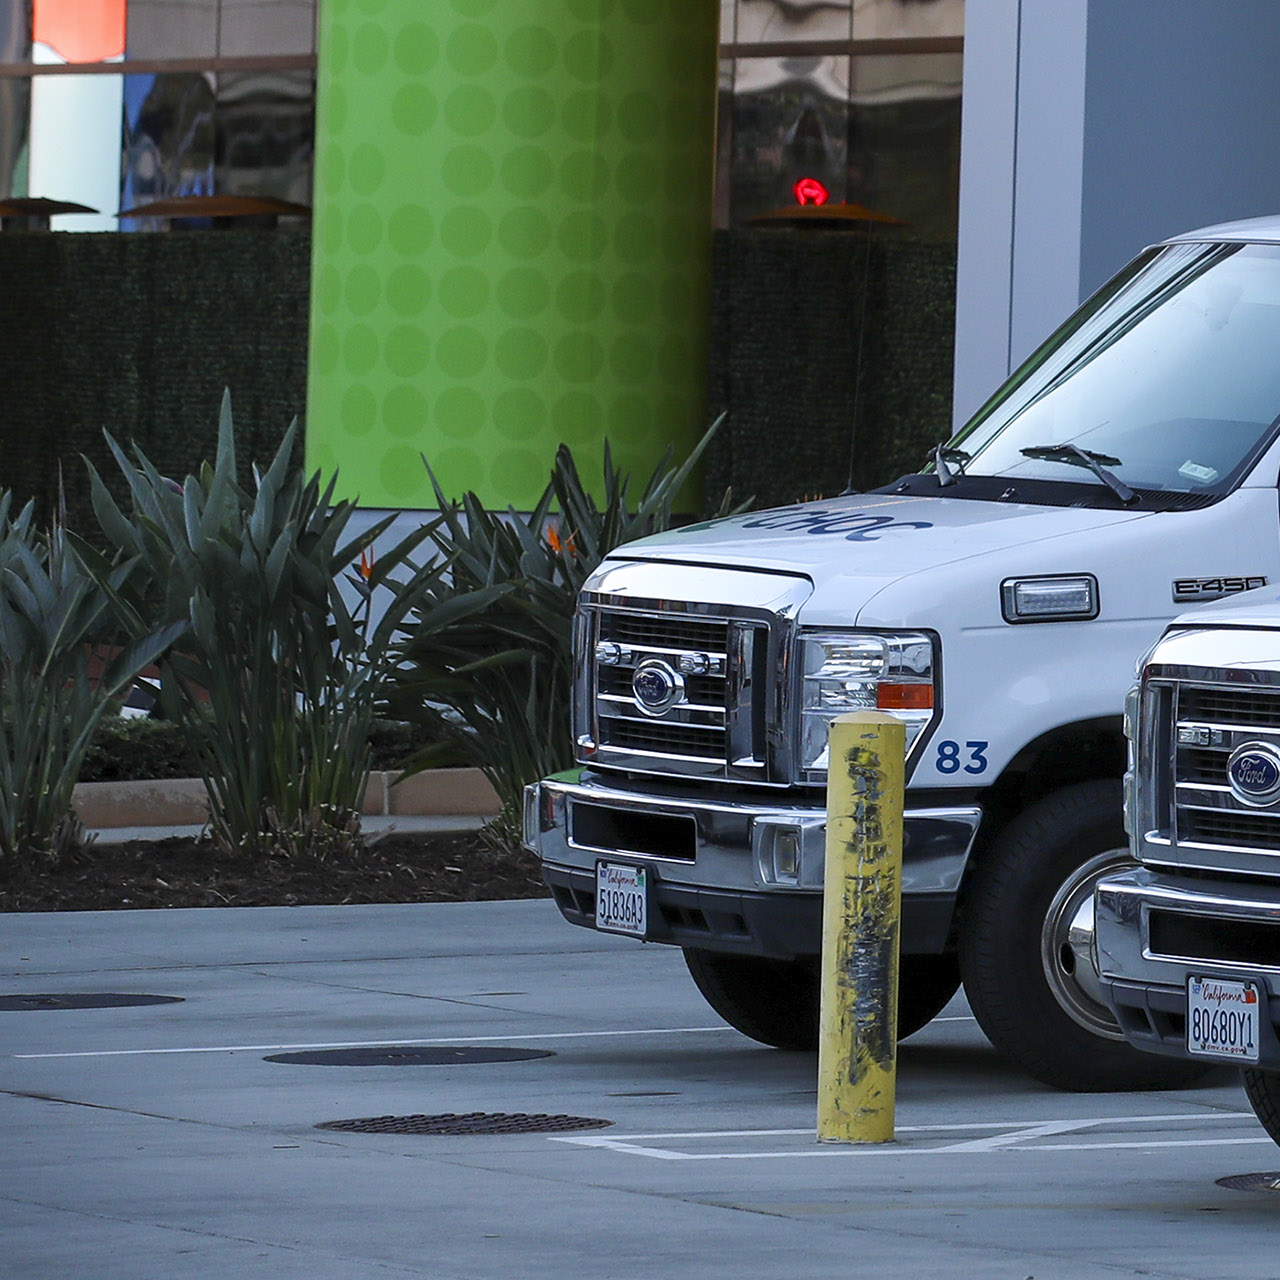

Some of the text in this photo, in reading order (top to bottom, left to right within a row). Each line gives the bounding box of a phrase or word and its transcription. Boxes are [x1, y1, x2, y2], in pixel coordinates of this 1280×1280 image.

[936, 740, 988, 774] 83
[1237, 757, 1267, 784] Ford
[599, 888, 644, 924] 51836A3
[1202, 983, 1246, 1007] California
[1192, 1007, 1254, 1048] 80680Y1
